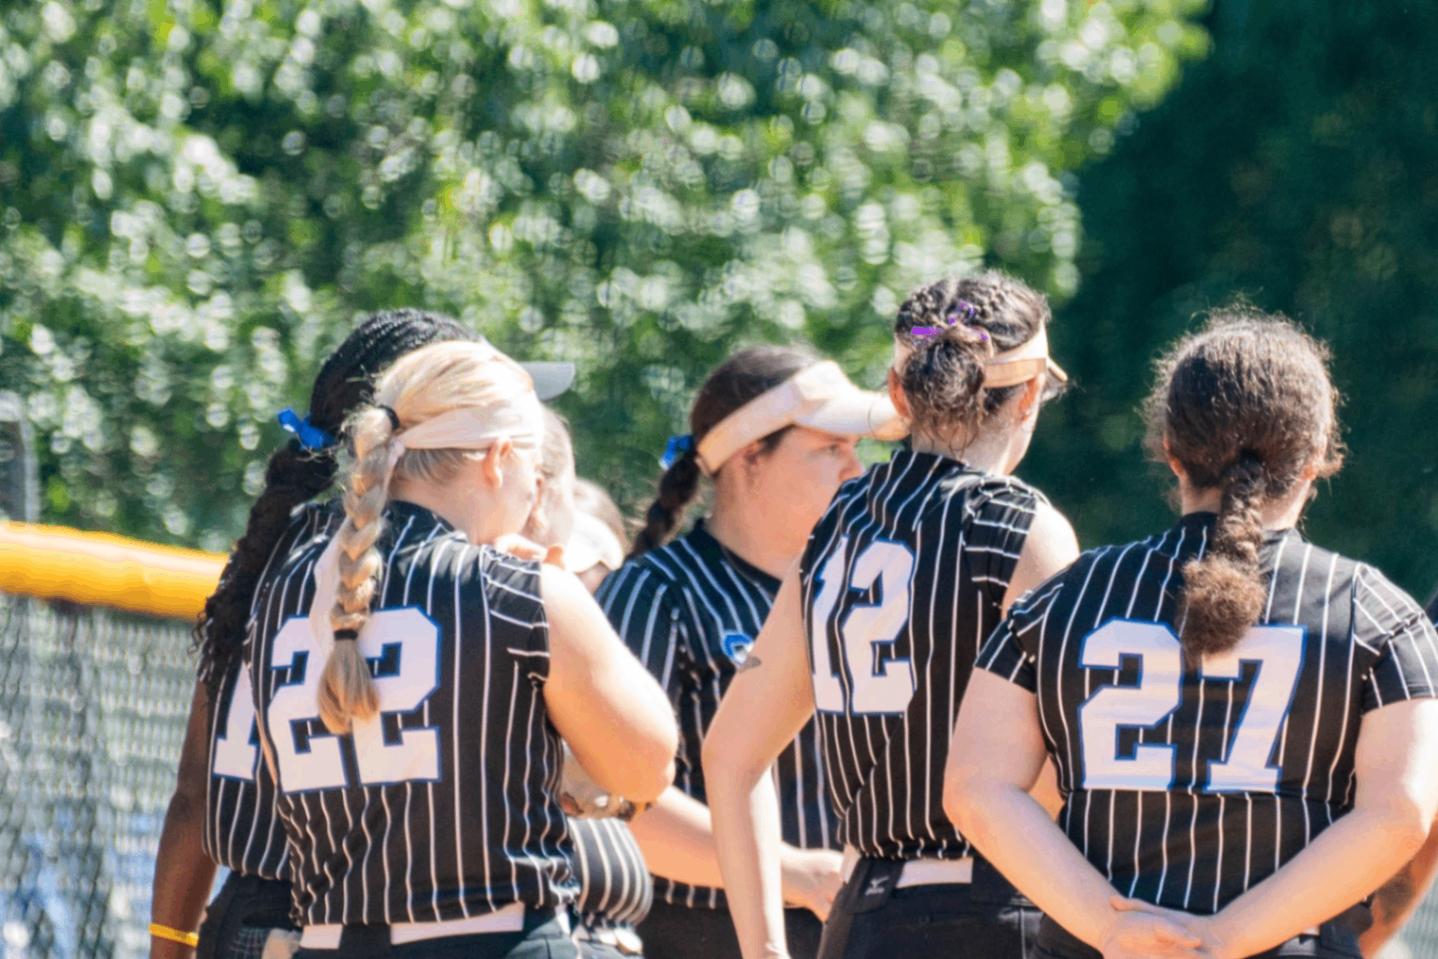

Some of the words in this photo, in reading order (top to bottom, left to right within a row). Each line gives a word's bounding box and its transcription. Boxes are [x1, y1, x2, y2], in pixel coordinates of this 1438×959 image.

[267, 605, 441, 794] 22
[812, 534, 917, 717] 12
[1078, 616, 1307, 793] 27
